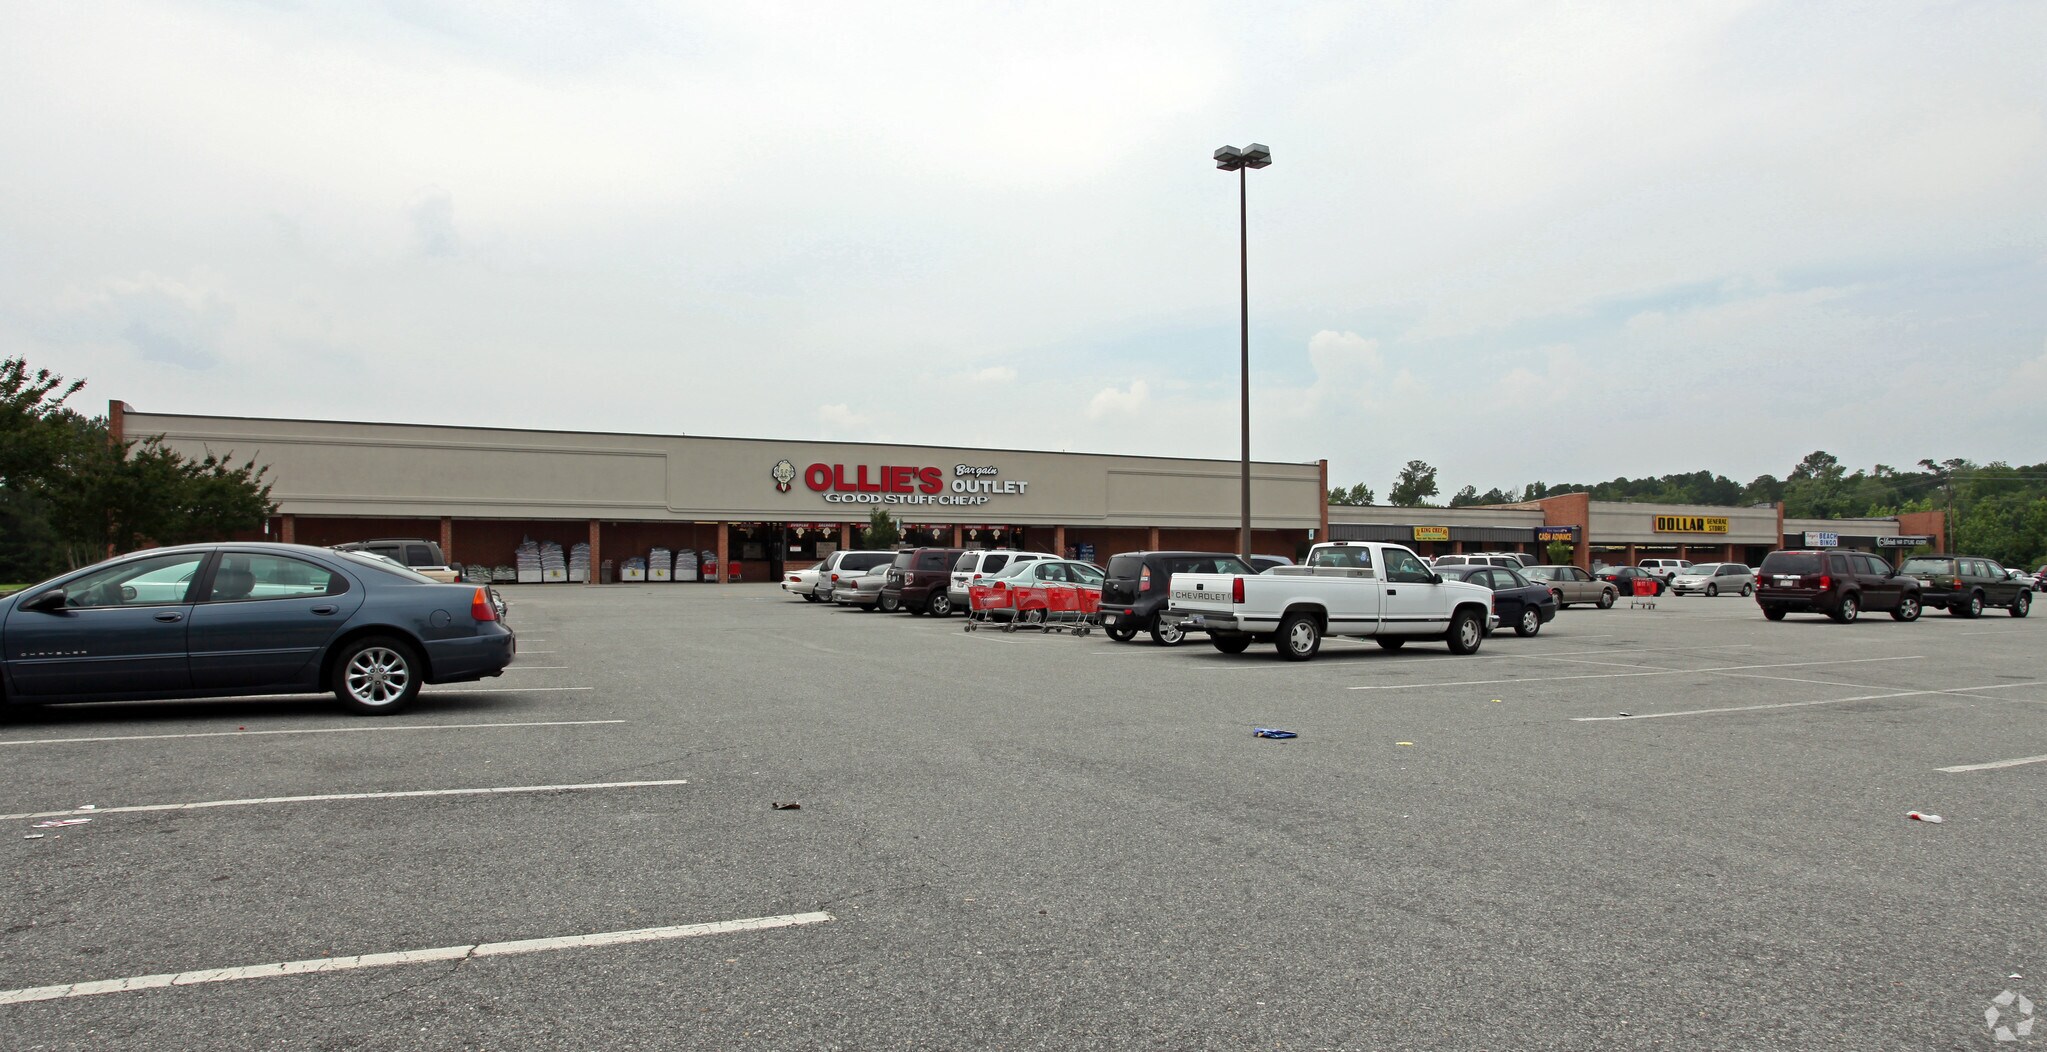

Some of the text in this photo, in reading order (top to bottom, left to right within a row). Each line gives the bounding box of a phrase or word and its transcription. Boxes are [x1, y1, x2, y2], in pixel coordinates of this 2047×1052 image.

[955, 464, 998, 478] Bargain
[804, 463, 944, 494] OLLIE'S
[951, 480, 1028, 494] OUTLET
[884, 494, 937, 505] STUFF
[1657, 517, 1705, 531] DOLLAR
[1551, 533, 1572, 541] ADVANCE
[1175, 591, 1226, 601] CHEVROLET
